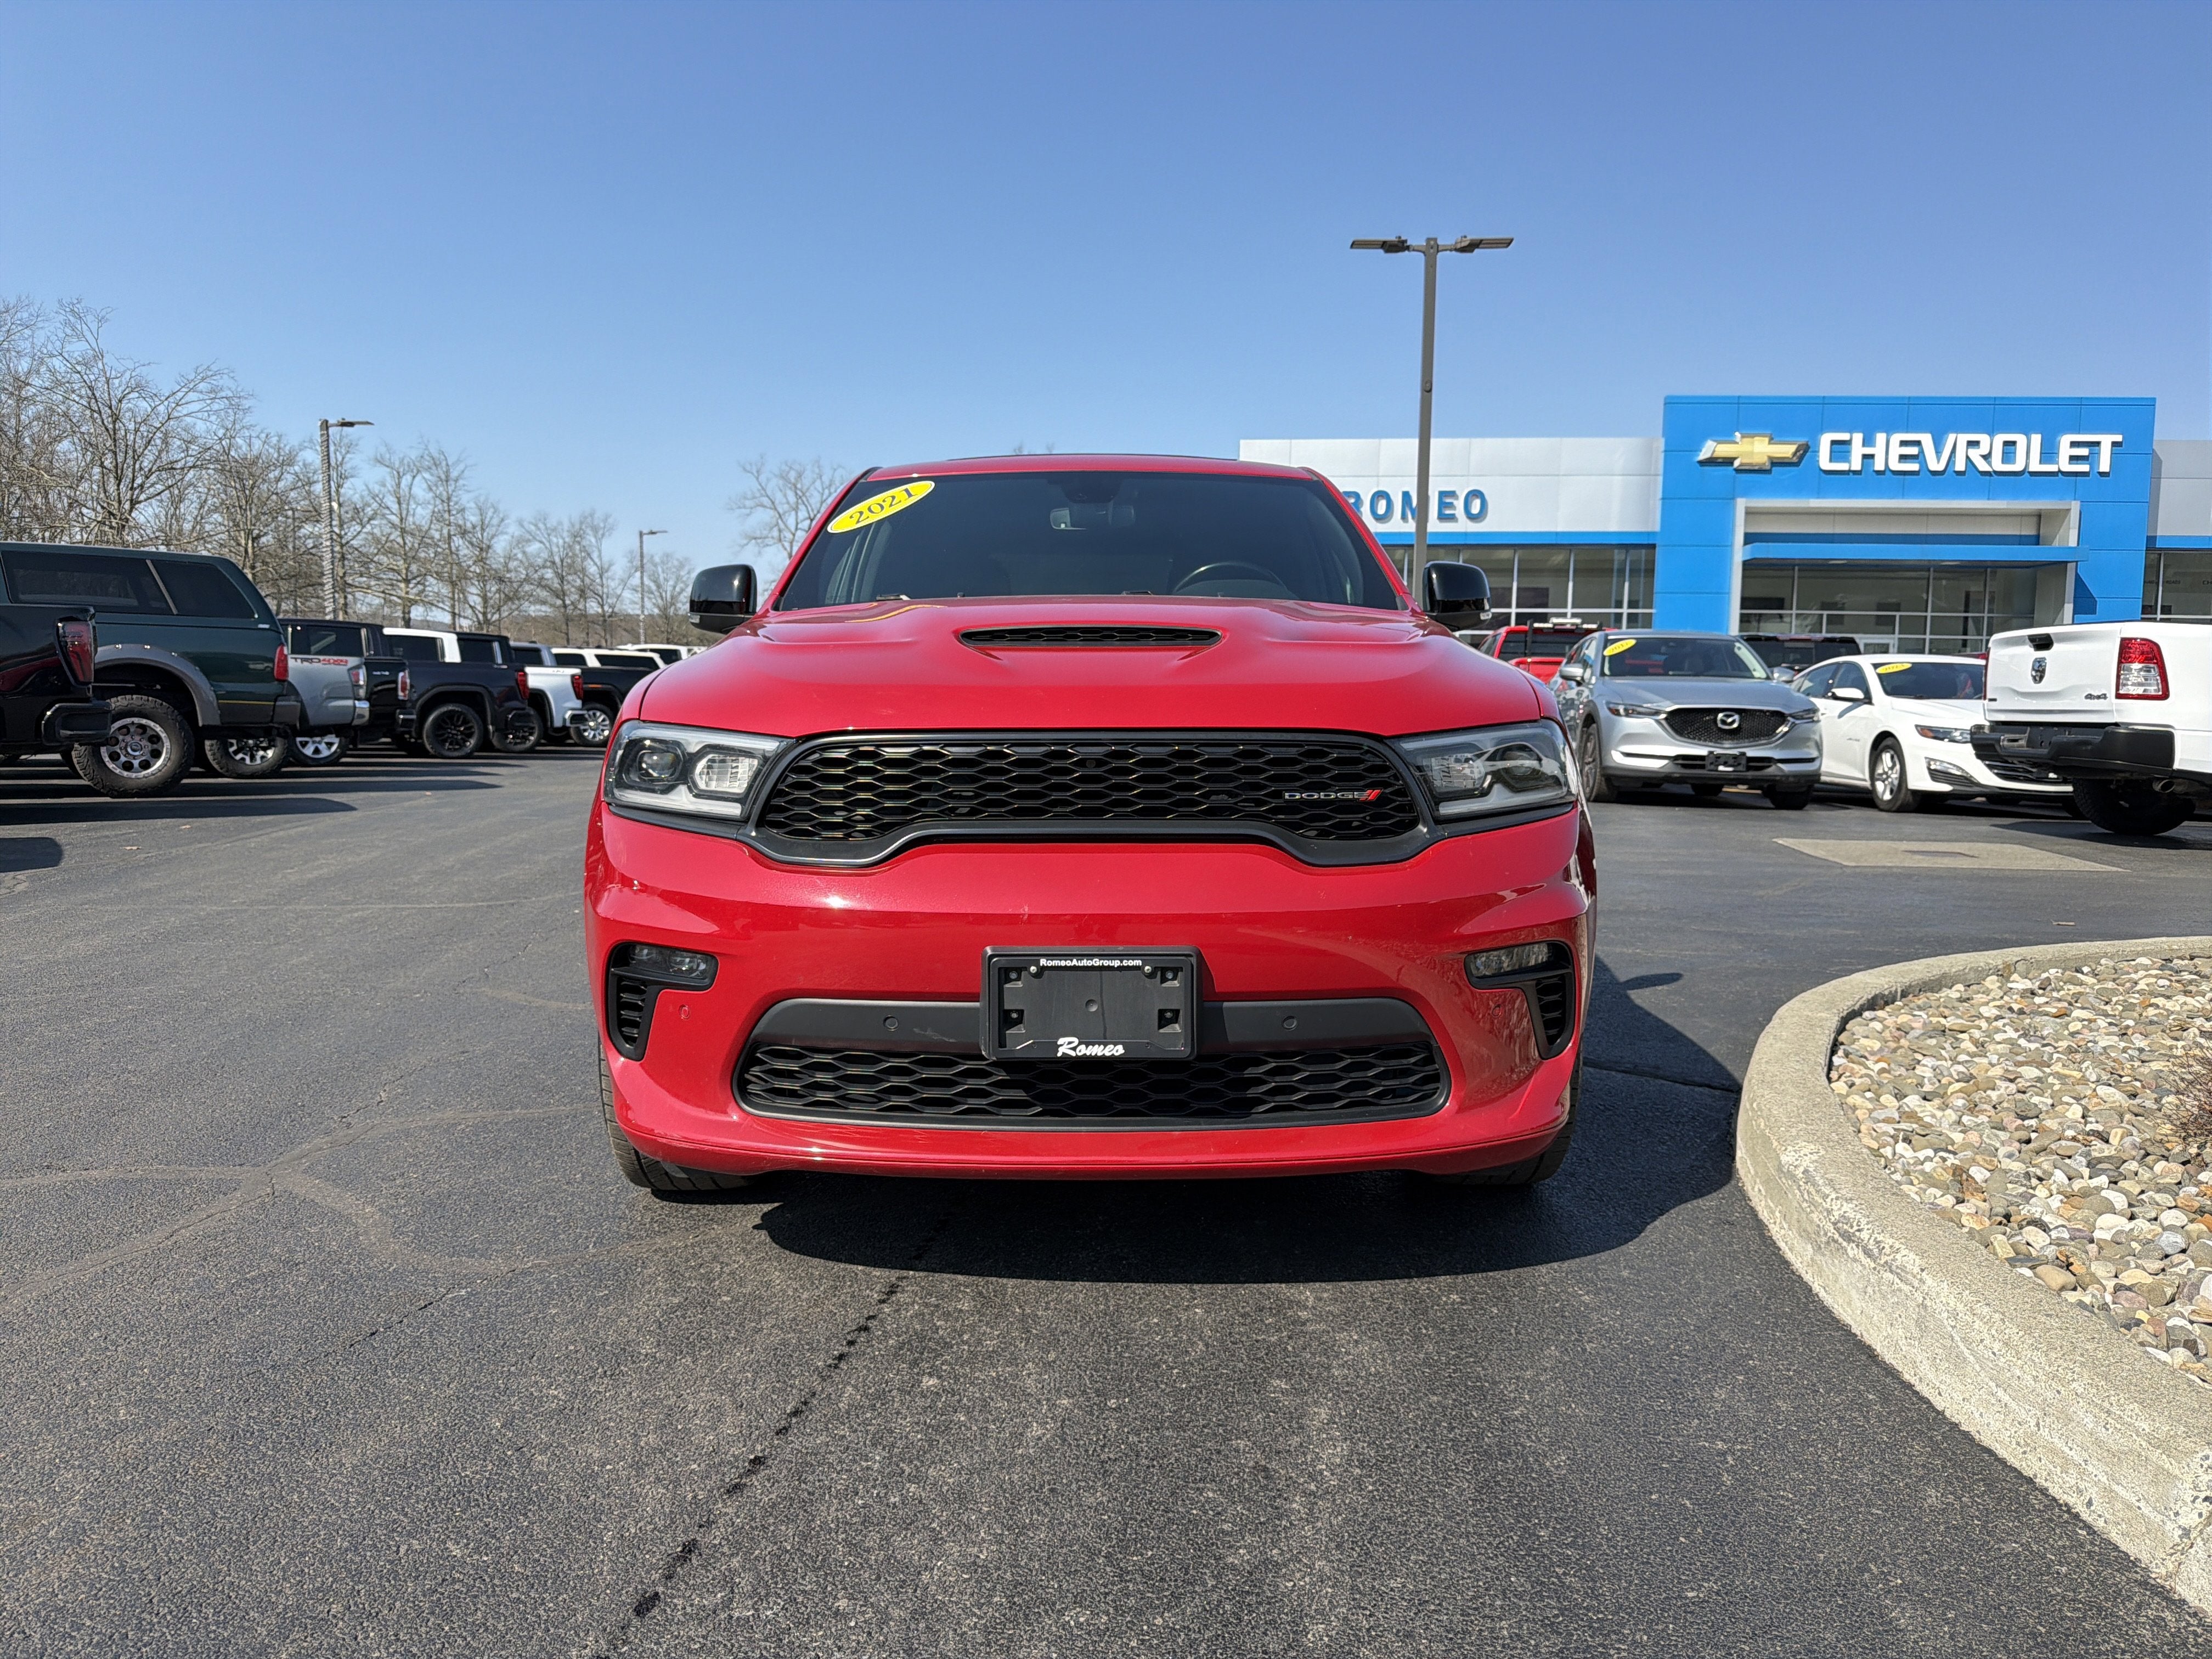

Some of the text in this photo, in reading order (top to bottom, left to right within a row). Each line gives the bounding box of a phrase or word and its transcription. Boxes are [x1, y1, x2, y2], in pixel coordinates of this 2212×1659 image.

[1819, 432, 2123, 473] CHEVROLET
[850, 487, 918, 524] 2021
[1284, 791, 1371, 800] DODGE
[1040, 958, 1142, 967] RomeoAutoGroup.com
[1057, 1036, 1125, 1057] Romeo
